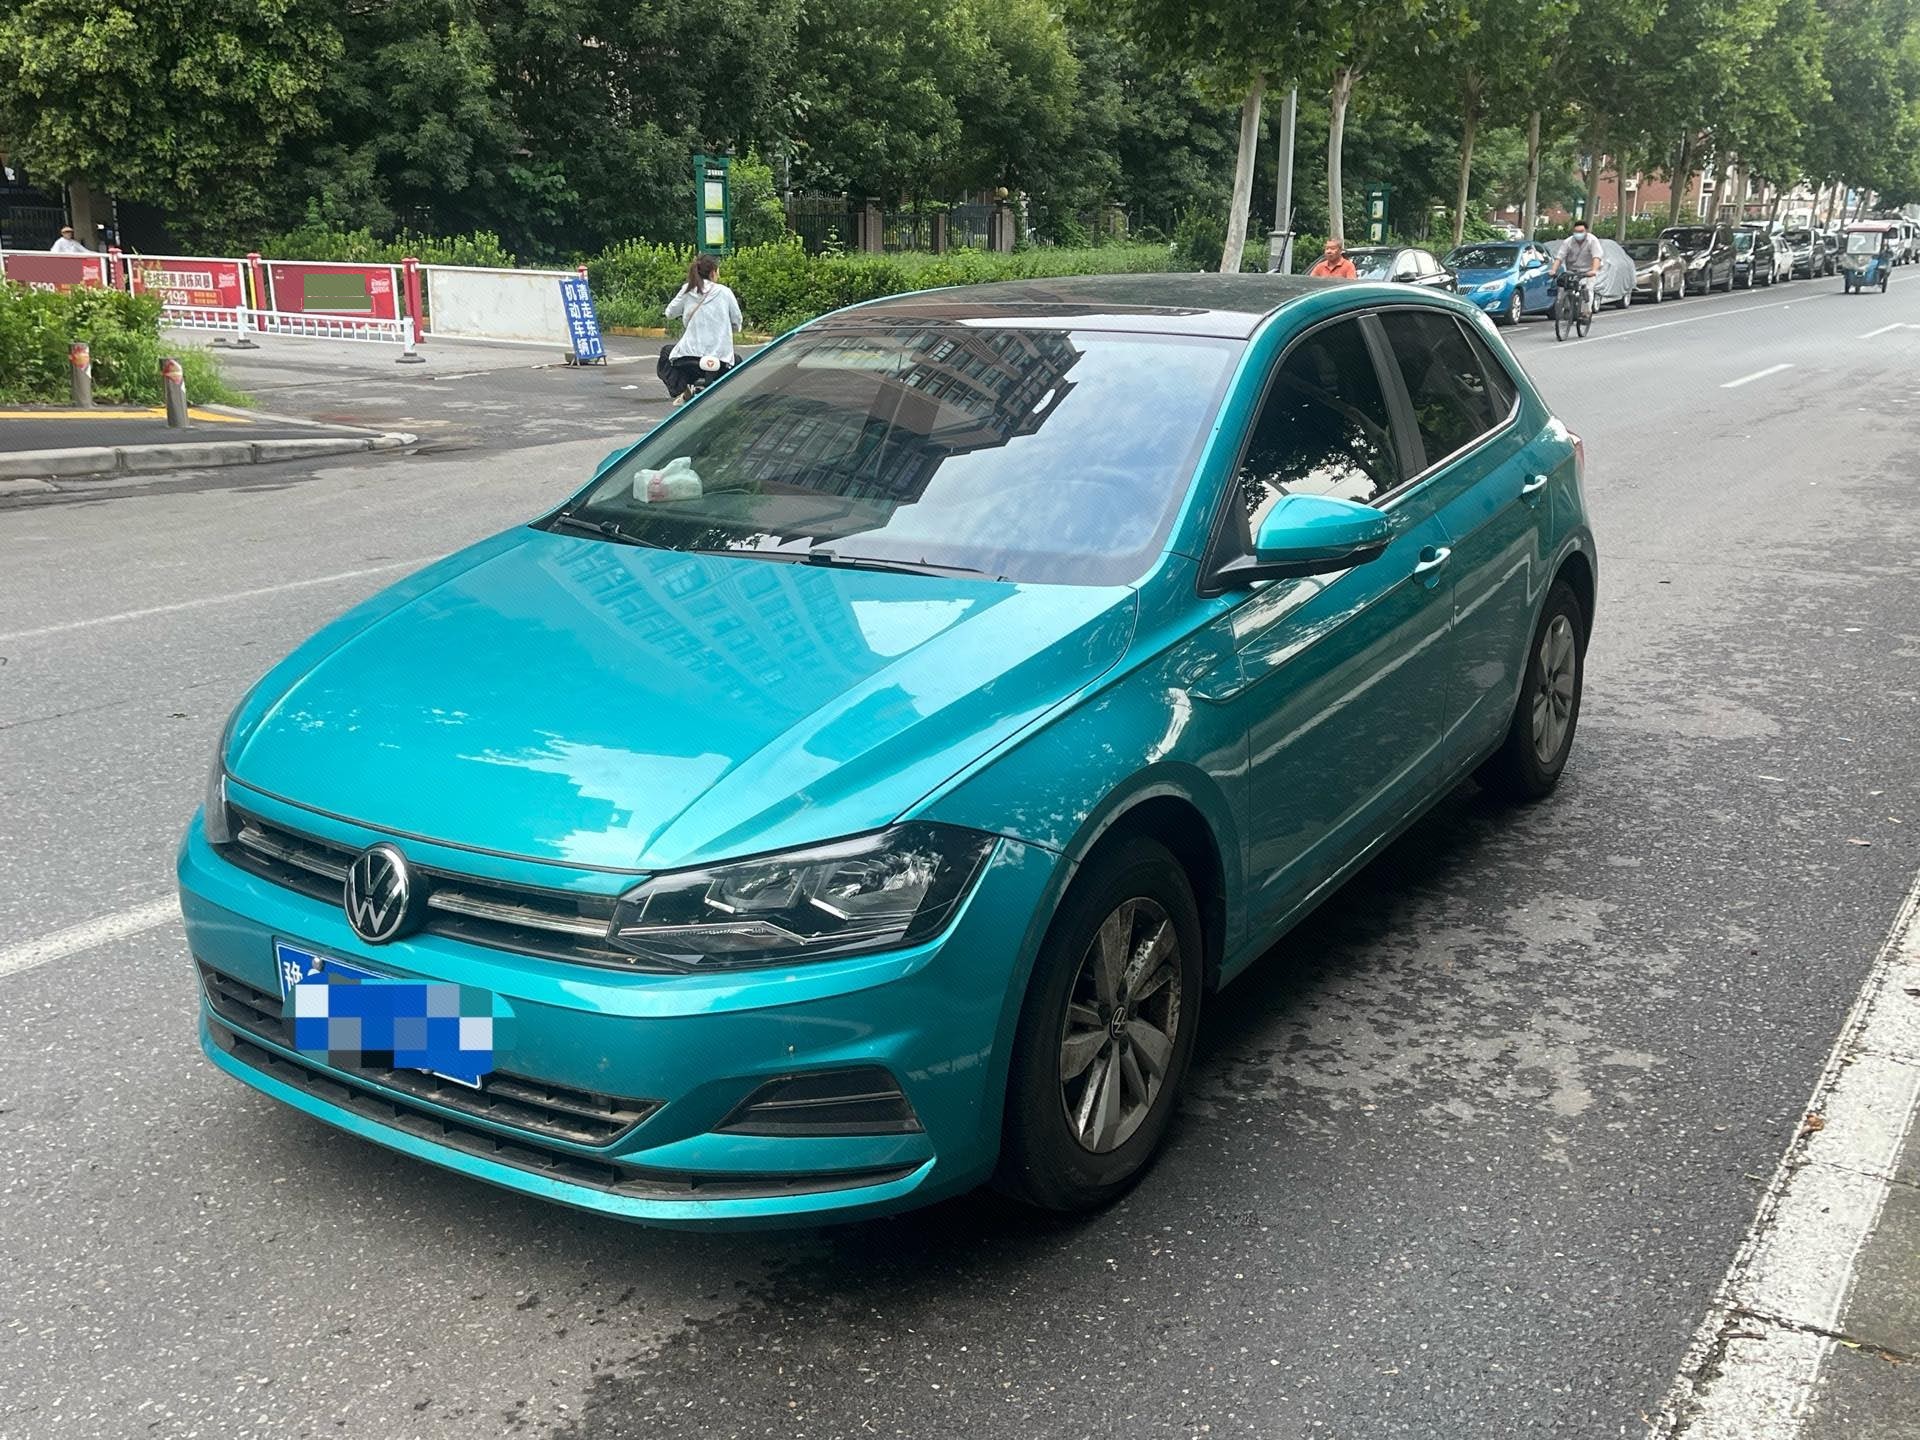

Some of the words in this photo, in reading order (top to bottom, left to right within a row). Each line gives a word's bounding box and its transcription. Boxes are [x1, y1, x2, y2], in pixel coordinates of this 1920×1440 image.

[564, 284, 590, 356] 机动车辆
[576, 283, 602, 355] 请走东门
